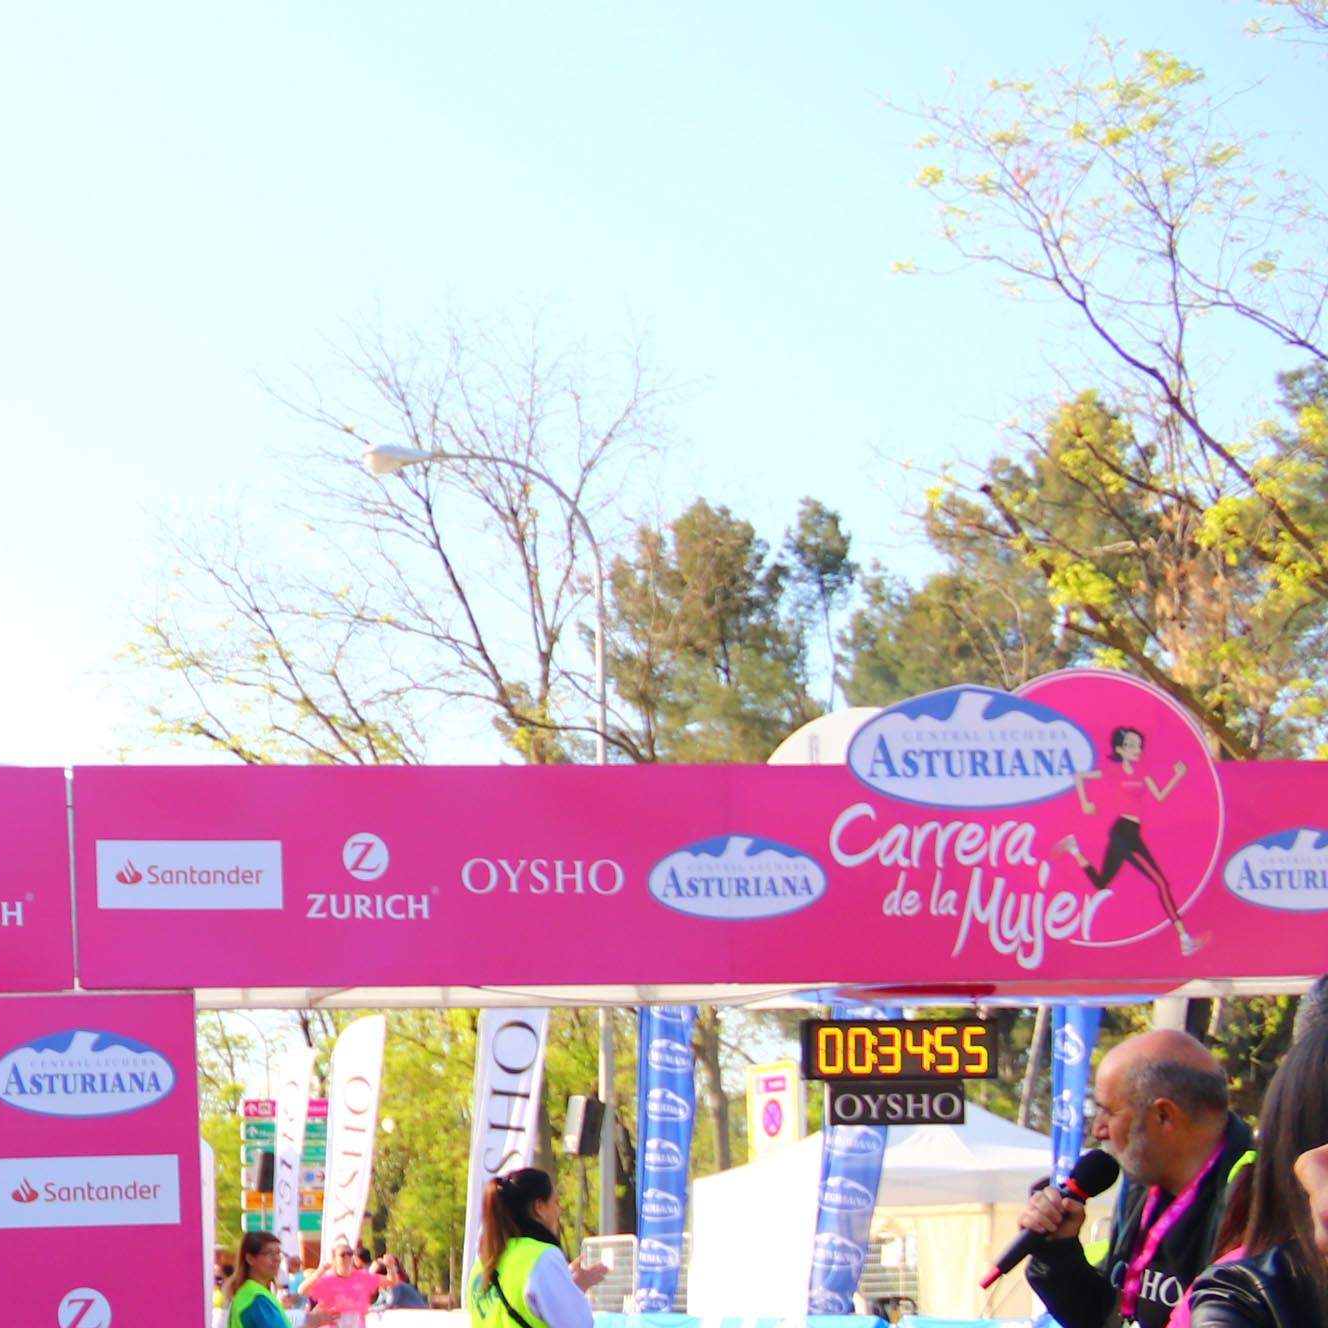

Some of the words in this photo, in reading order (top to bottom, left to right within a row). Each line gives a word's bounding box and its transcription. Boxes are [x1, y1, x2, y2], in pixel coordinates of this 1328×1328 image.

[868, 733, 1076, 779] ASTURIANA
[830, 802, 1036, 870] Carrera
[146, 863, 264, 888] Santander
[461, 858, 625, 897] OYSHO
[663, 866, 814, 898] ASTURIANA
[306, 894, 431, 921] ZURICH
[882, 872, 921, 919] de
[929, 876, 957, 916] la
[952, 862, 1113, 970] Mujer
[3, 1062, 163, 1095] ASTURIANA
[483, 1020, 538, 1174] SHO
[834, 1092, 963, 1123] OYSHO
[44, 1180, 162, 1202] Santander
